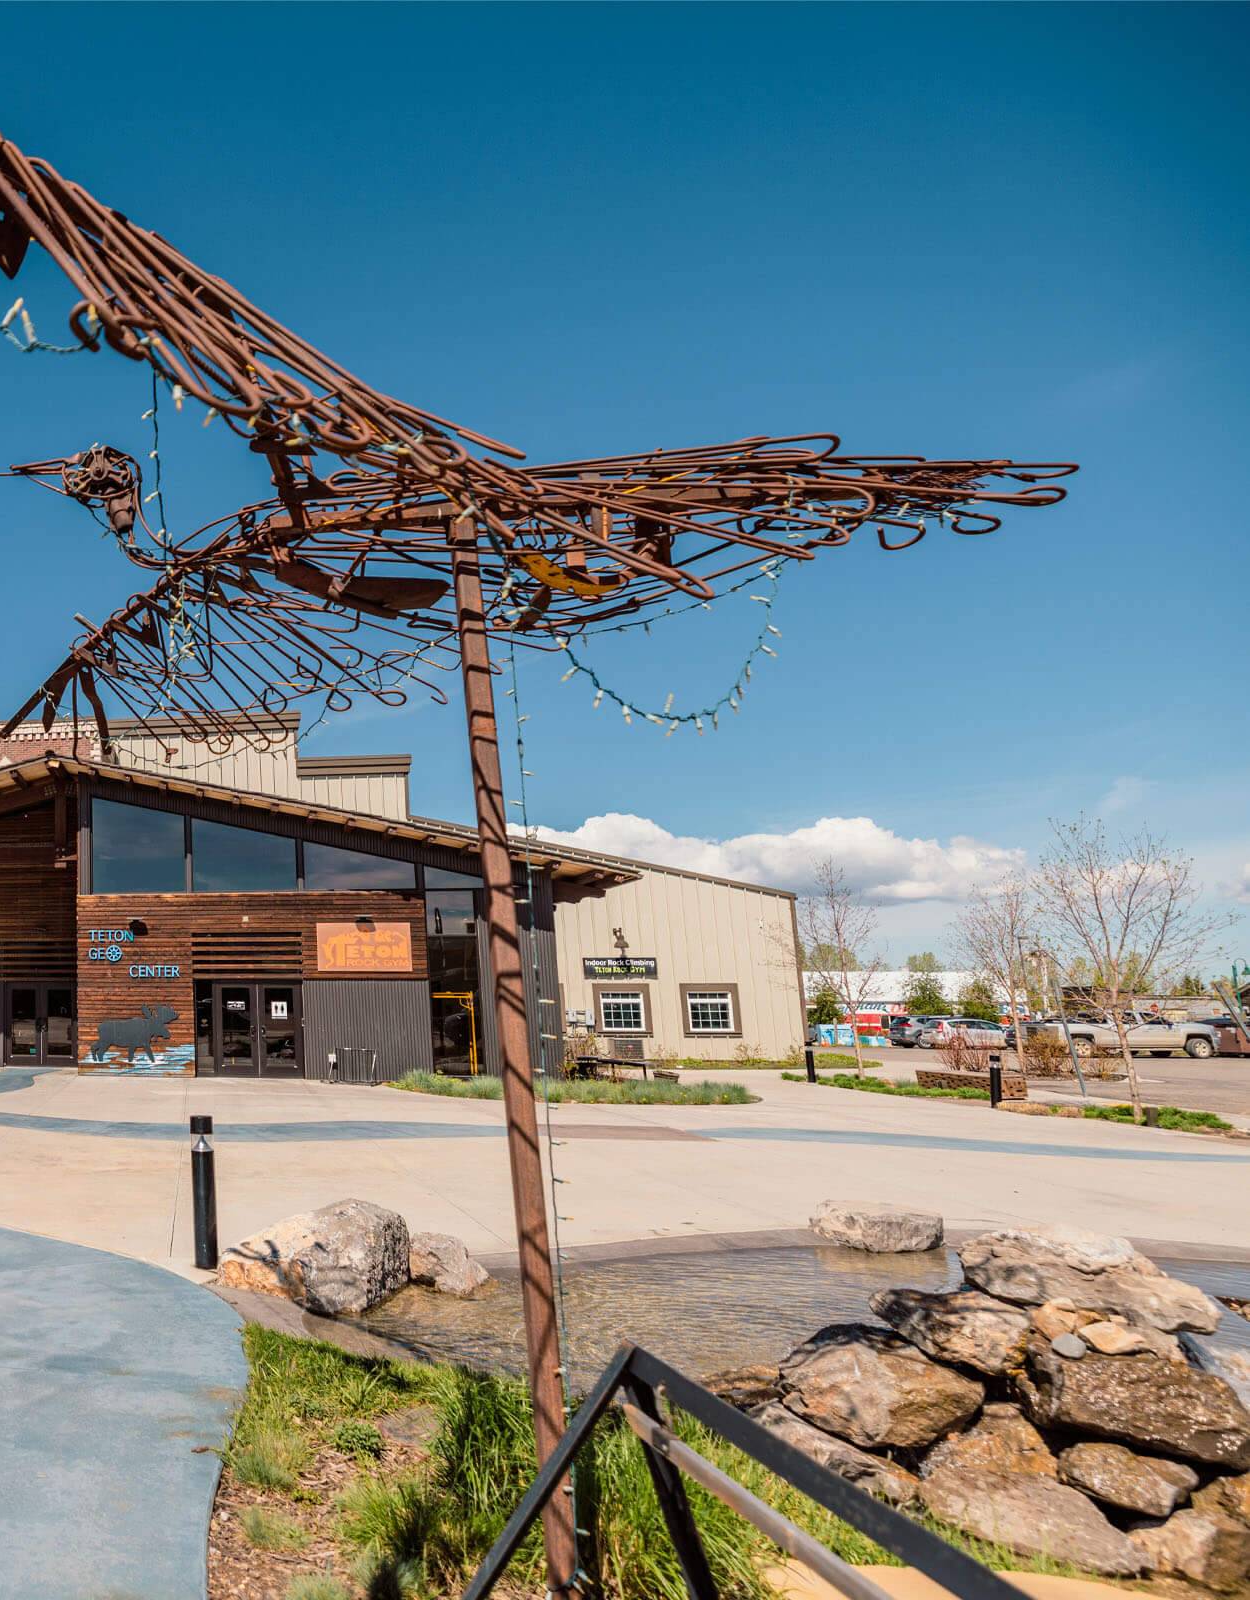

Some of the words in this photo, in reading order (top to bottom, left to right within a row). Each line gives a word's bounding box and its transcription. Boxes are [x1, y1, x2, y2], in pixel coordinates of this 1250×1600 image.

[88, 929, 134, 942] TETON
[346, 958, 379, 968] ROCK
[382, 958, 410, 968] GYM
[625, 959, 655, 968] Climbing
[129, 965, 181, 978] CENTER
